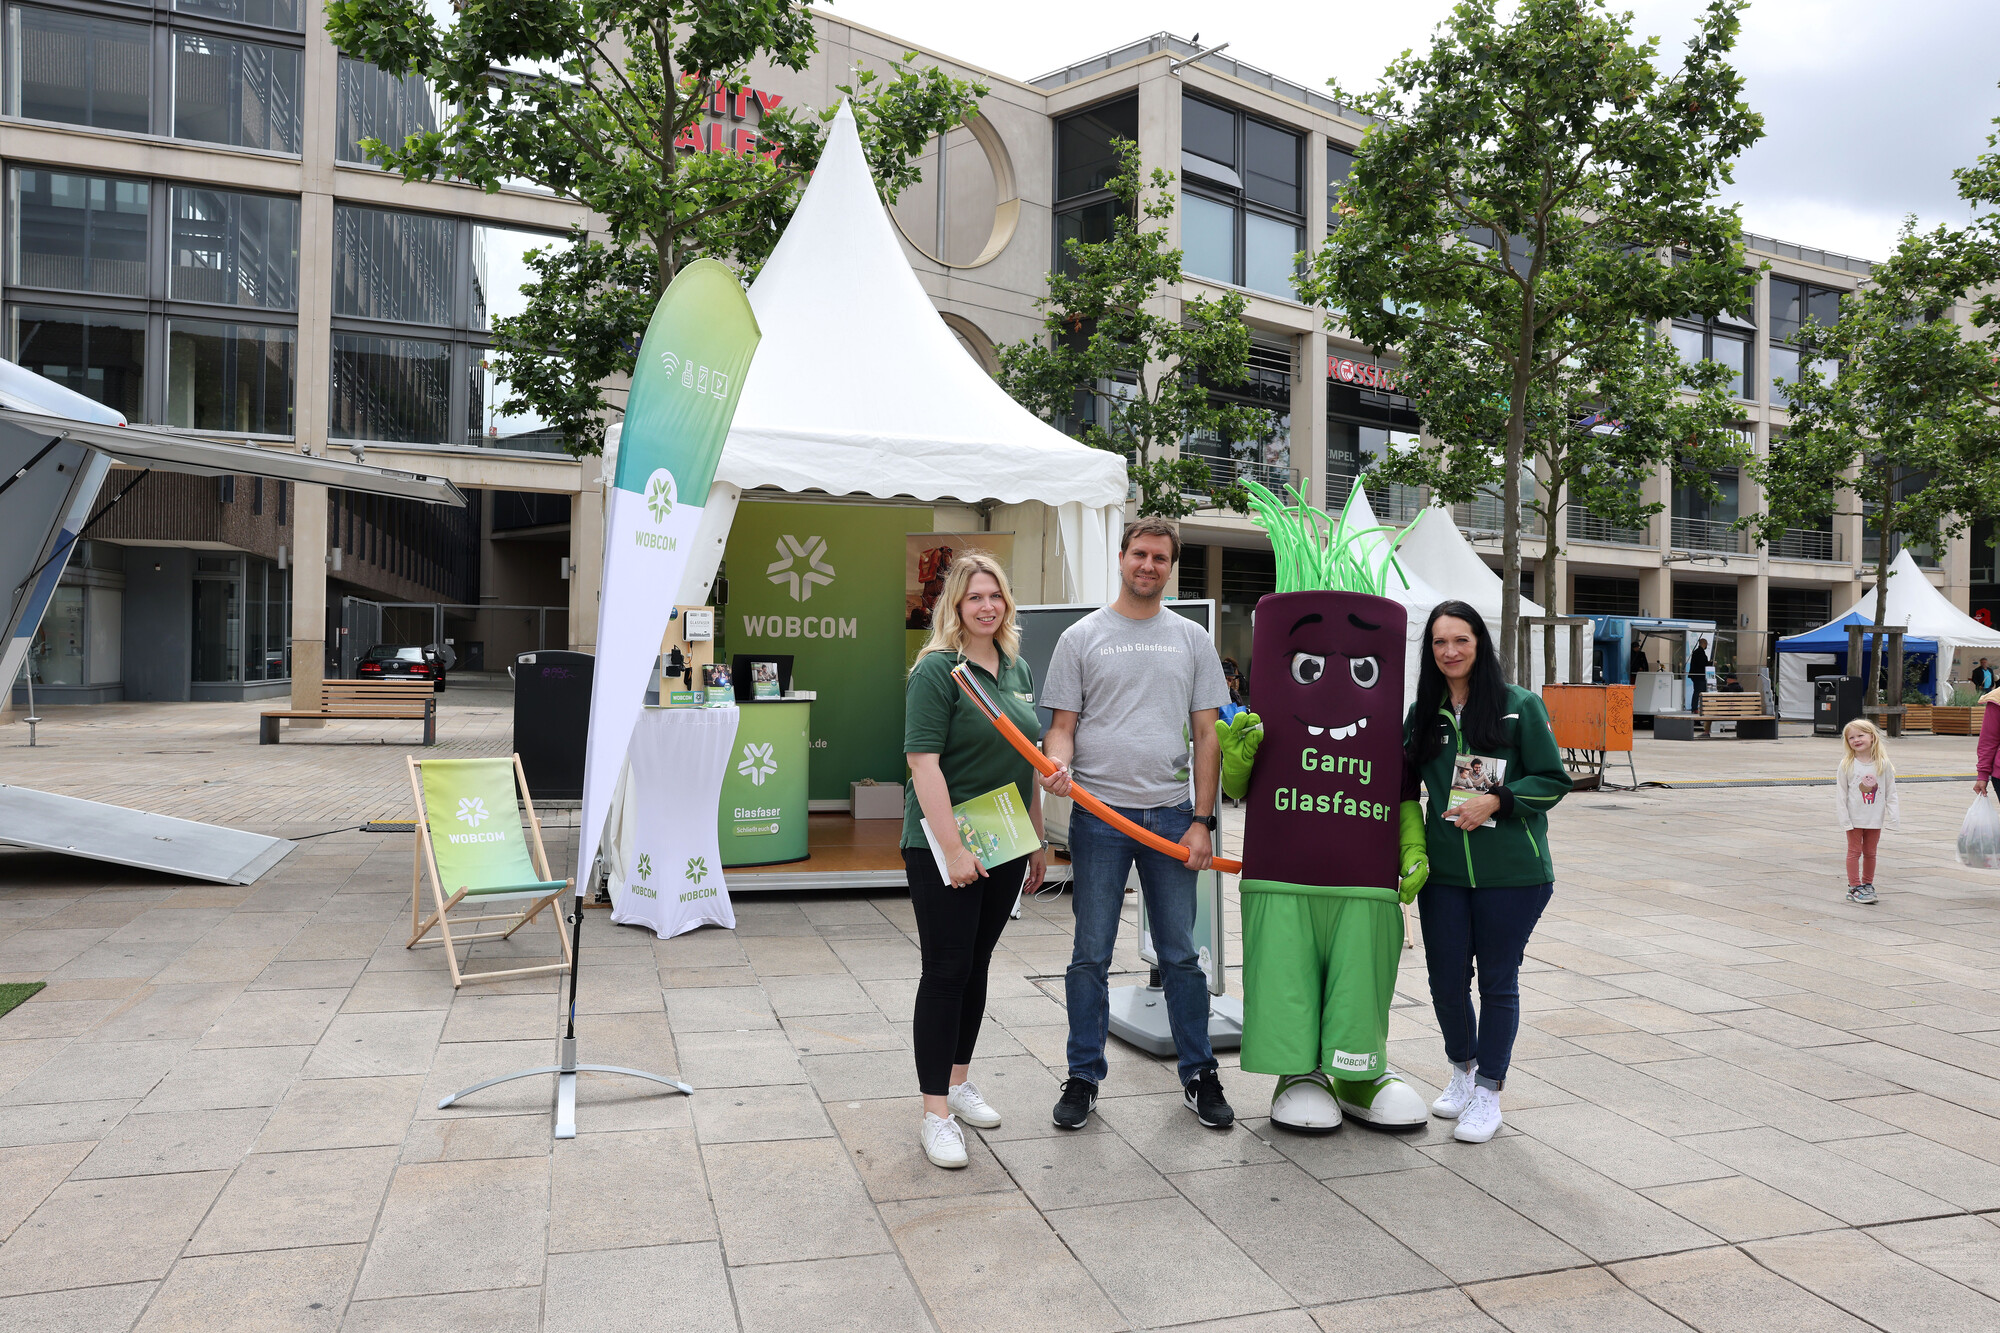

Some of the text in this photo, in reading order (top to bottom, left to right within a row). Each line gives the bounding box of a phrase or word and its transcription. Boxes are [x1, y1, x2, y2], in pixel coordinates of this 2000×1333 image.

[635, 530, 677, 552] WOBCOM
[1179, 590, 1201, 600] EMPEL
[742, 615, 857, 639] WOBCOM
[1100, 643, 1183, 656] Ich hab Glasfaser...
[1301, 747, 1372, 785] Garry
[1274, 787, 1391, 822] Glasfaser
[734, 807, 781, 819] Glasfaser
[448, 831, 506, 845] WOBCOM
[631, 884, 657, 900] WOBCOM
[679, 887, 718, 904] WOBCOM
[1336, 1055, 1368, 1067] WOBCOM
